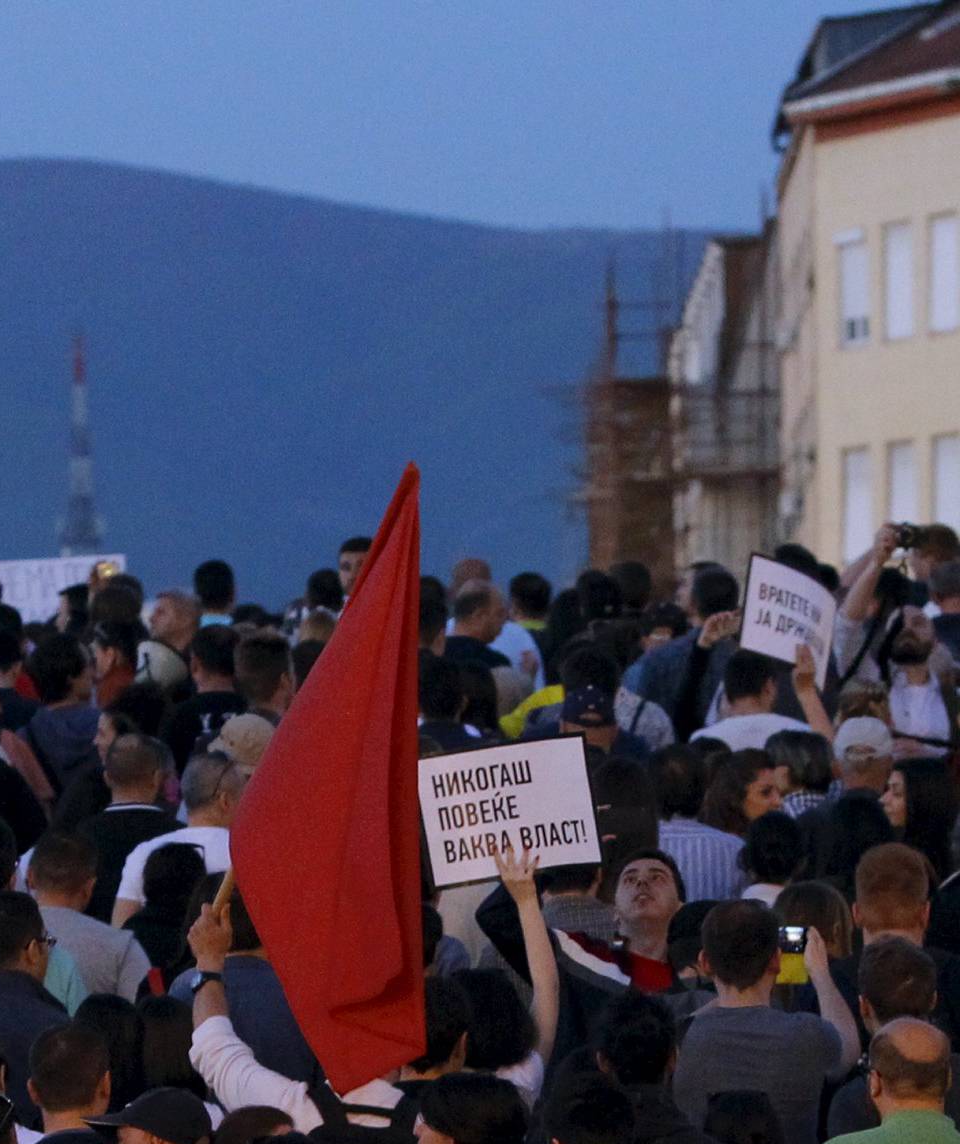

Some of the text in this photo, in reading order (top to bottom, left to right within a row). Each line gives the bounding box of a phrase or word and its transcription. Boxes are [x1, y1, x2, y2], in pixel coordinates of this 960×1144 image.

[758, 583, 810, 617] ВРАТЕТЕ
[431, 759, 532, 798] НИКОГАШ
[438, 791, 520, 831] ПОВЕЌЕ
[443, 819, 588, 864] ВАКВА ВЛАСТ!
